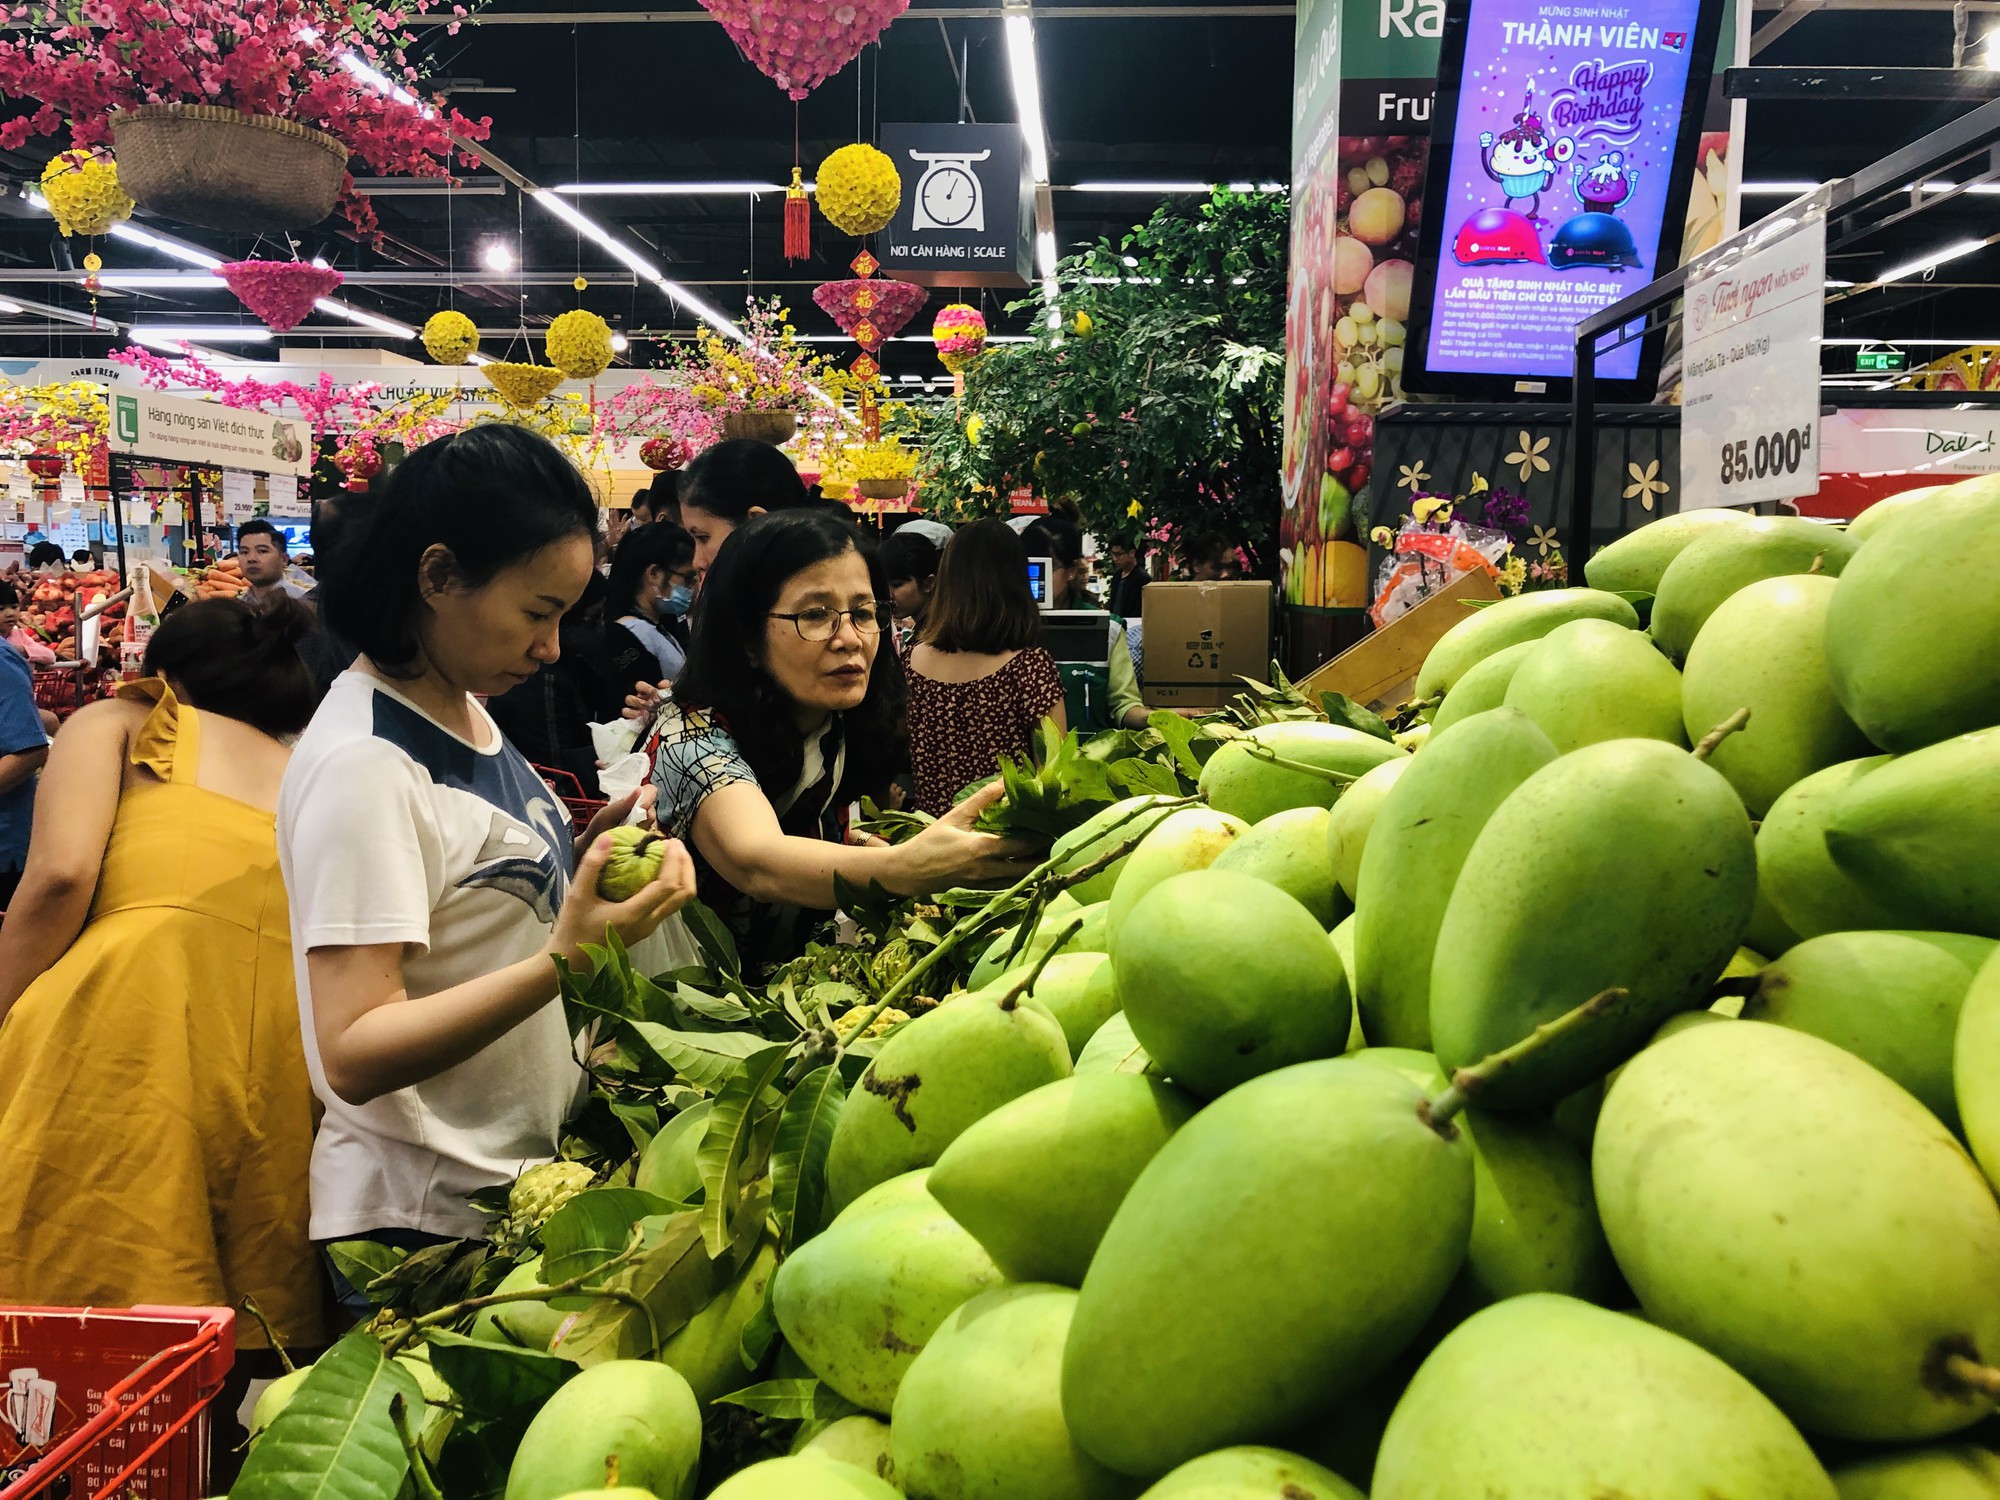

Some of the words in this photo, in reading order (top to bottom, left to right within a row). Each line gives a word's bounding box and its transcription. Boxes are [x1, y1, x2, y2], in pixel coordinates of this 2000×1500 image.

[1573, 7, 1599, 18] SINH
[1601, 7, 1630, 20] NHẬT
[1502, 18, 1592, 47] THÀNH
[1600, 21, 1659, 49] VIÊN
[1575, 64, 1649, 101] Happy
[1554, 91, 1645, 127] Birthday
[890, 245, 908, 257] NƠI
[911, 245, 933, 257] CÂN
[935, 244, 965, 258] HÀNG
[974, 247, 1006, 258] SCALE
[856, 256, 873, 275] 福
[1461, 277, 1484, 288] QUÀ
[1516, 280, 1542, 290] SINH
[1543, 280, 1573, 293] NHẬT
[1599, 282, 1622, 294] BIỆT
[1740, 272, 1773, 317] ngon
[1789, 262, 1811, 283] NGÀY
[856, 290, 873, 309] 福
[1539, 292, 1554, 302] CÓ
[1573, 294, 1604, 304] LOTTE
[856, 324, 873, 343] 福
[856, 358, 873, 377] 福
[1717, 353, 1726, 367] Ta
[1860, 358, 1875, 366] EXIT
[94, 367, 120, 380] FRESH
[148, 406, 171, 426] Hàng
[173, 412, 195, 430] nông
[197, 414, 211, 430] sản
[212, 418, 229, 433] Việt
[230, 420, 246, 436] đích
[1926, 430, 1996, 454] Dalat
[1721, 423, 1811, 485] 85.000đ
